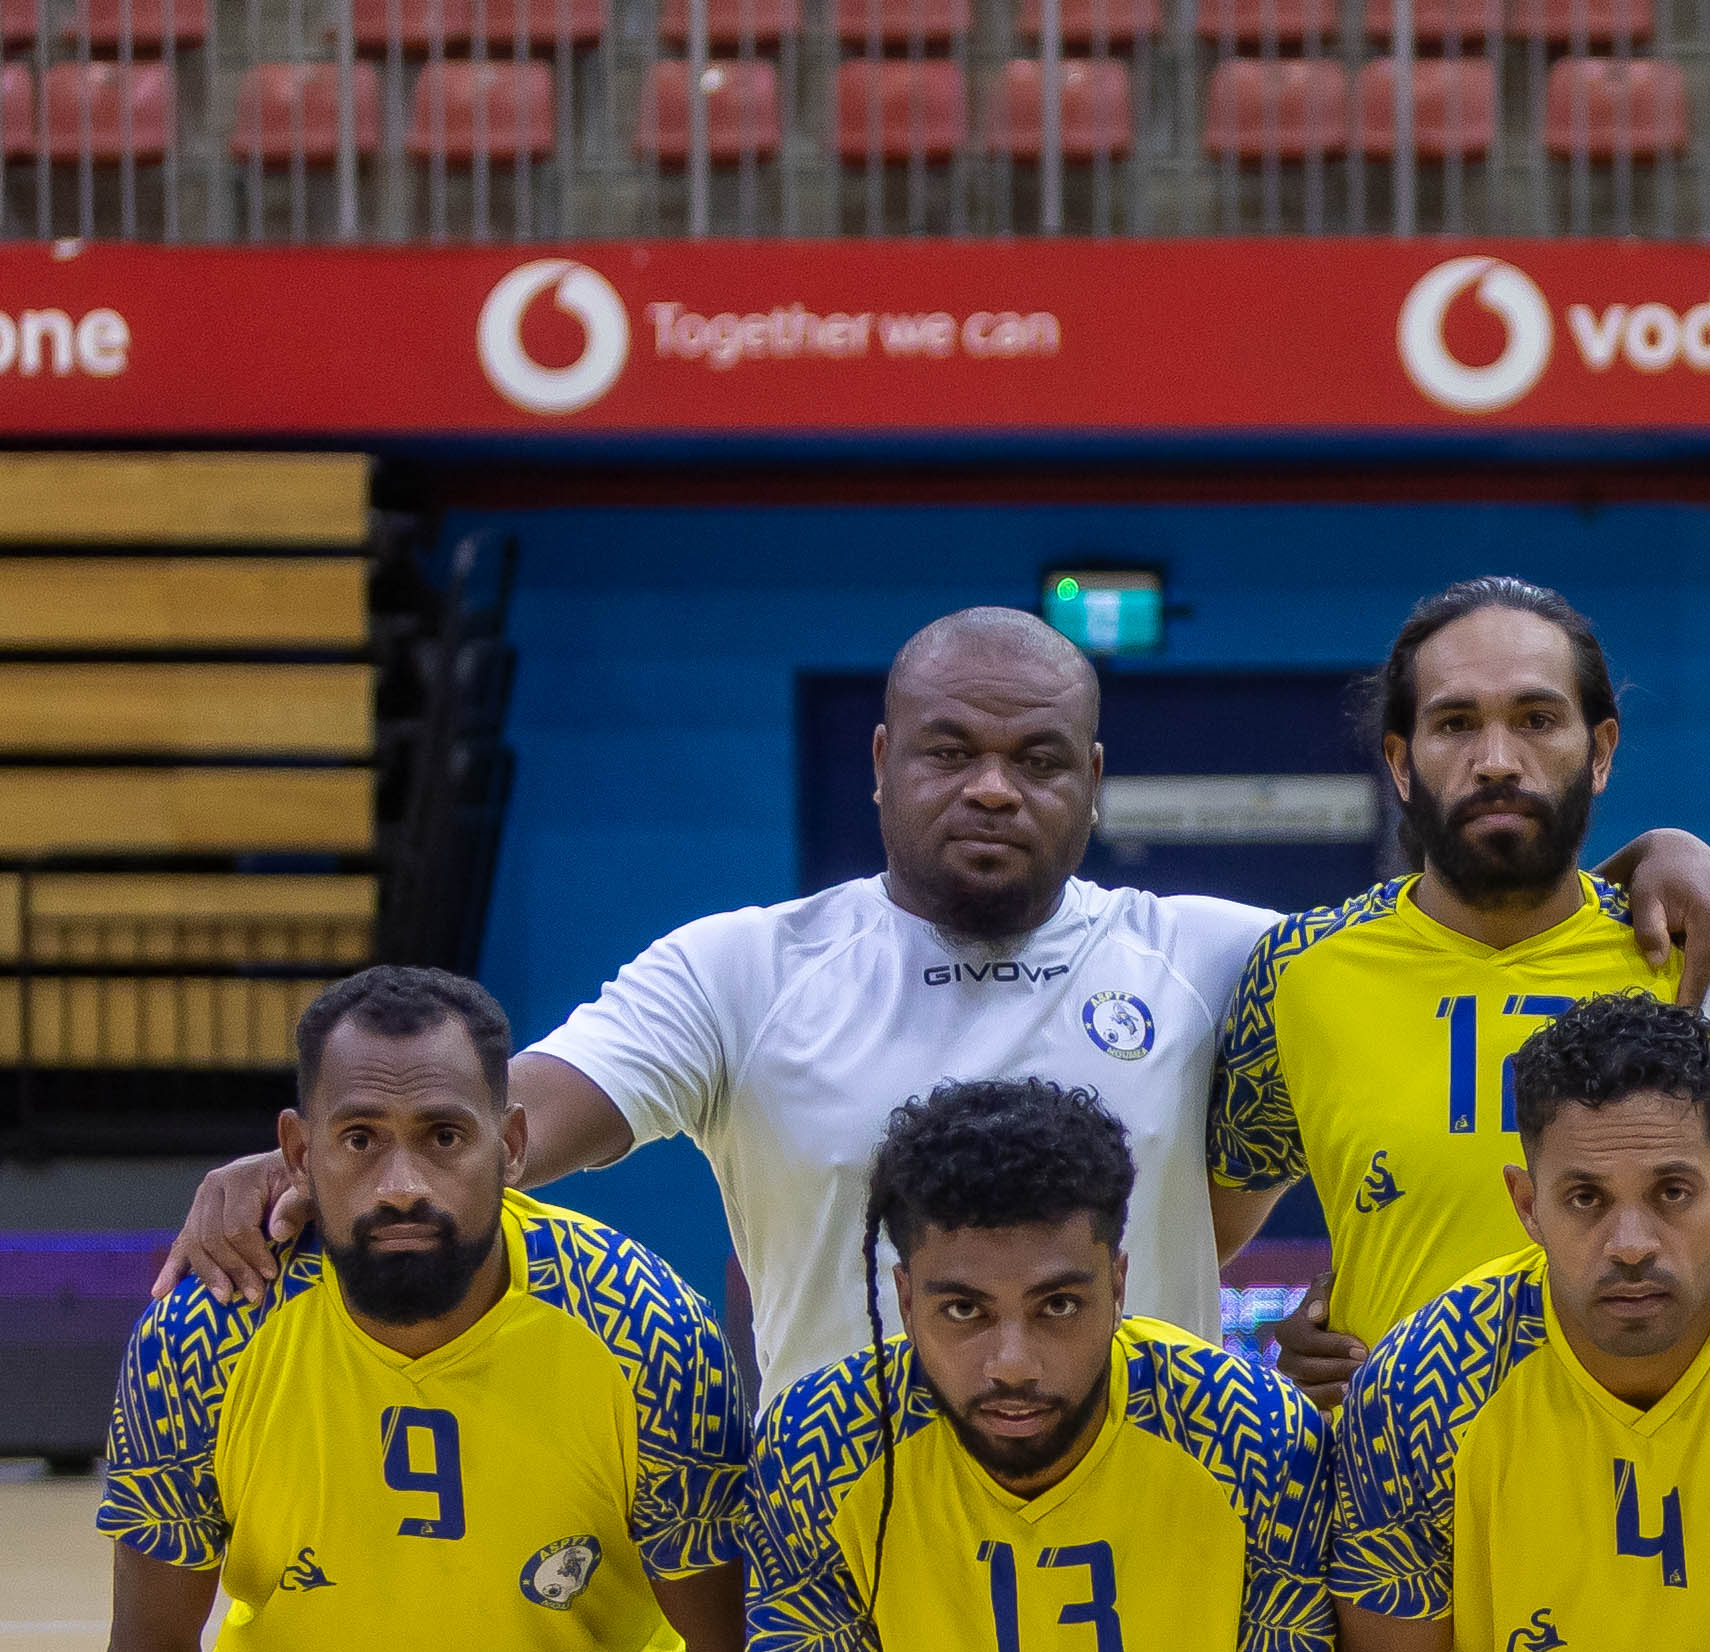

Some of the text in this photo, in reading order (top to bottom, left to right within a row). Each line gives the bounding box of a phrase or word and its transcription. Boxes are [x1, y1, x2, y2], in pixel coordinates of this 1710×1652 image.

[648, 299, 1060, 369] Together we can
[380, 1405, 466, 1540] 9
[1613, 1457, 1688, 1589] 4
